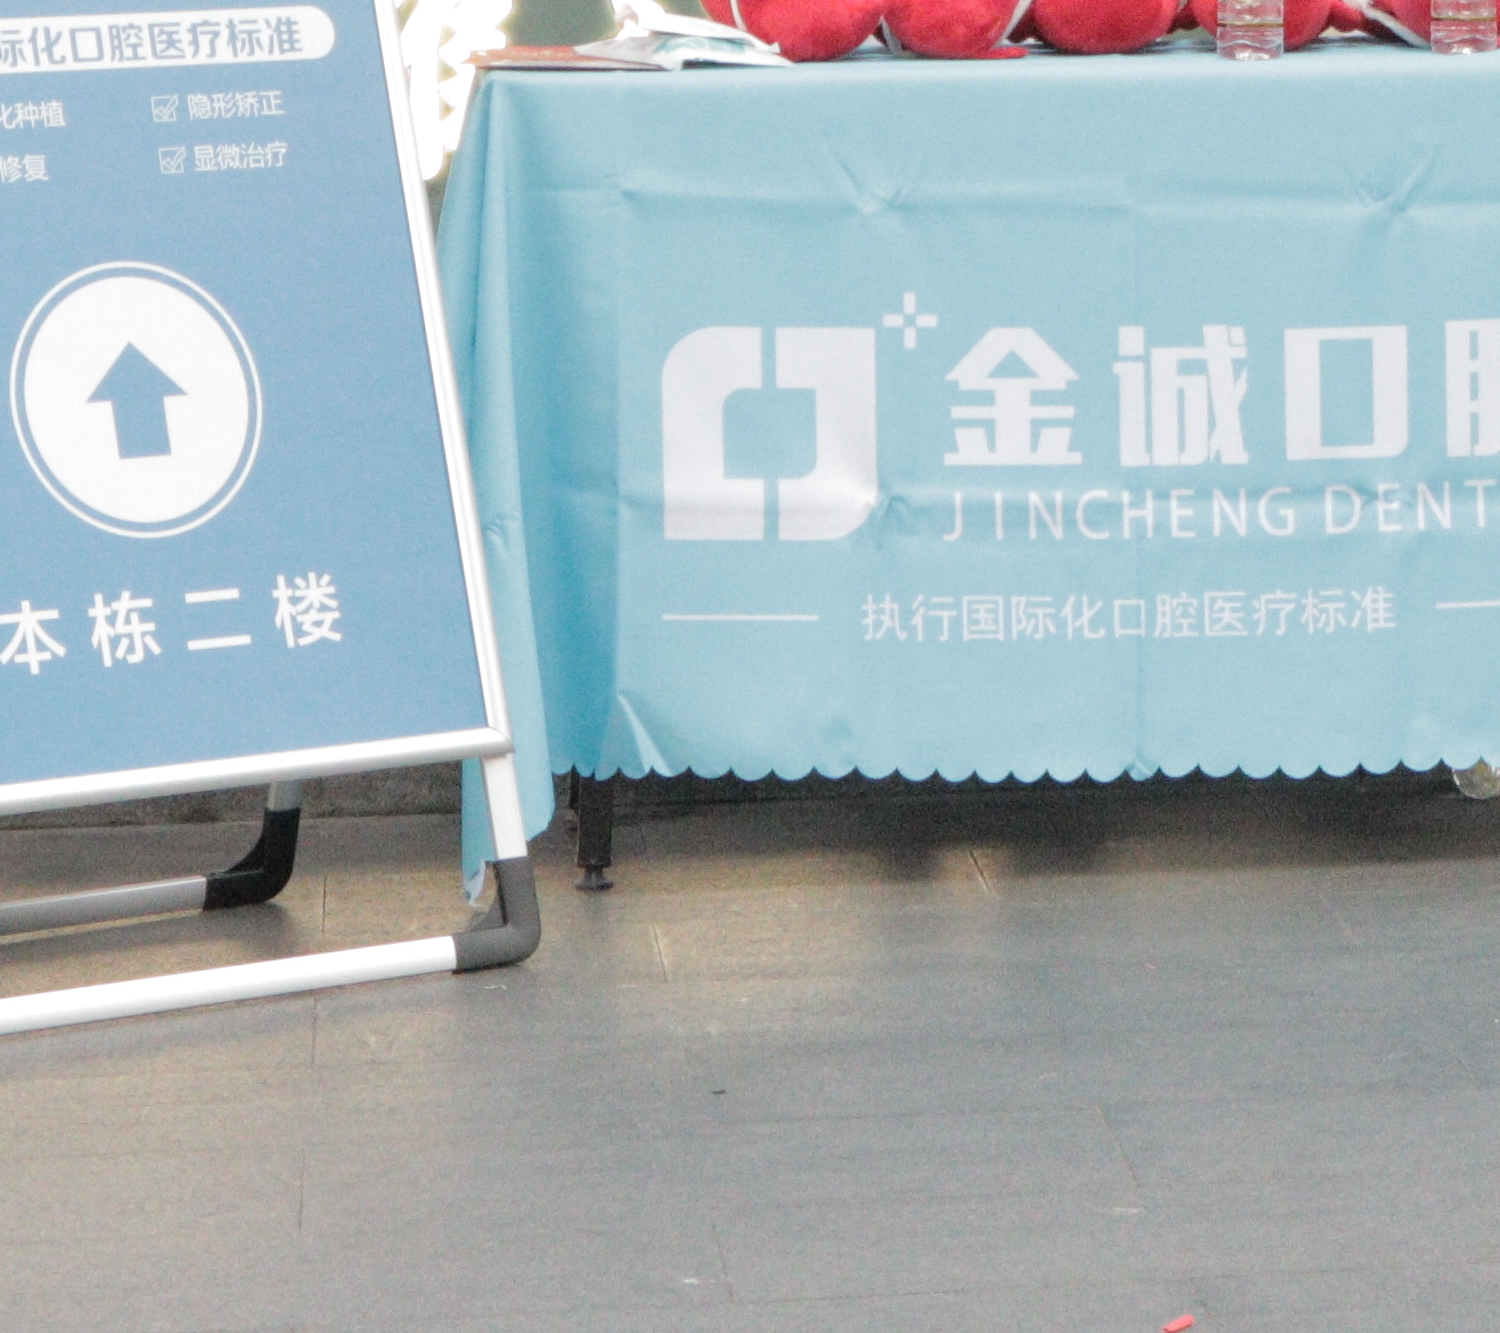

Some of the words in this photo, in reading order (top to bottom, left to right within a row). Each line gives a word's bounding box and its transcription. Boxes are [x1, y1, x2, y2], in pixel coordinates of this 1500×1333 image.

[186, 91, 285, 121] 隐形矫正
[193, 140, 289, 172] 显微治疗
[943, 486, 1297, 543] JINCHENG
[861, 590, 1397, 644] 执行国际化口腔医疗标准
